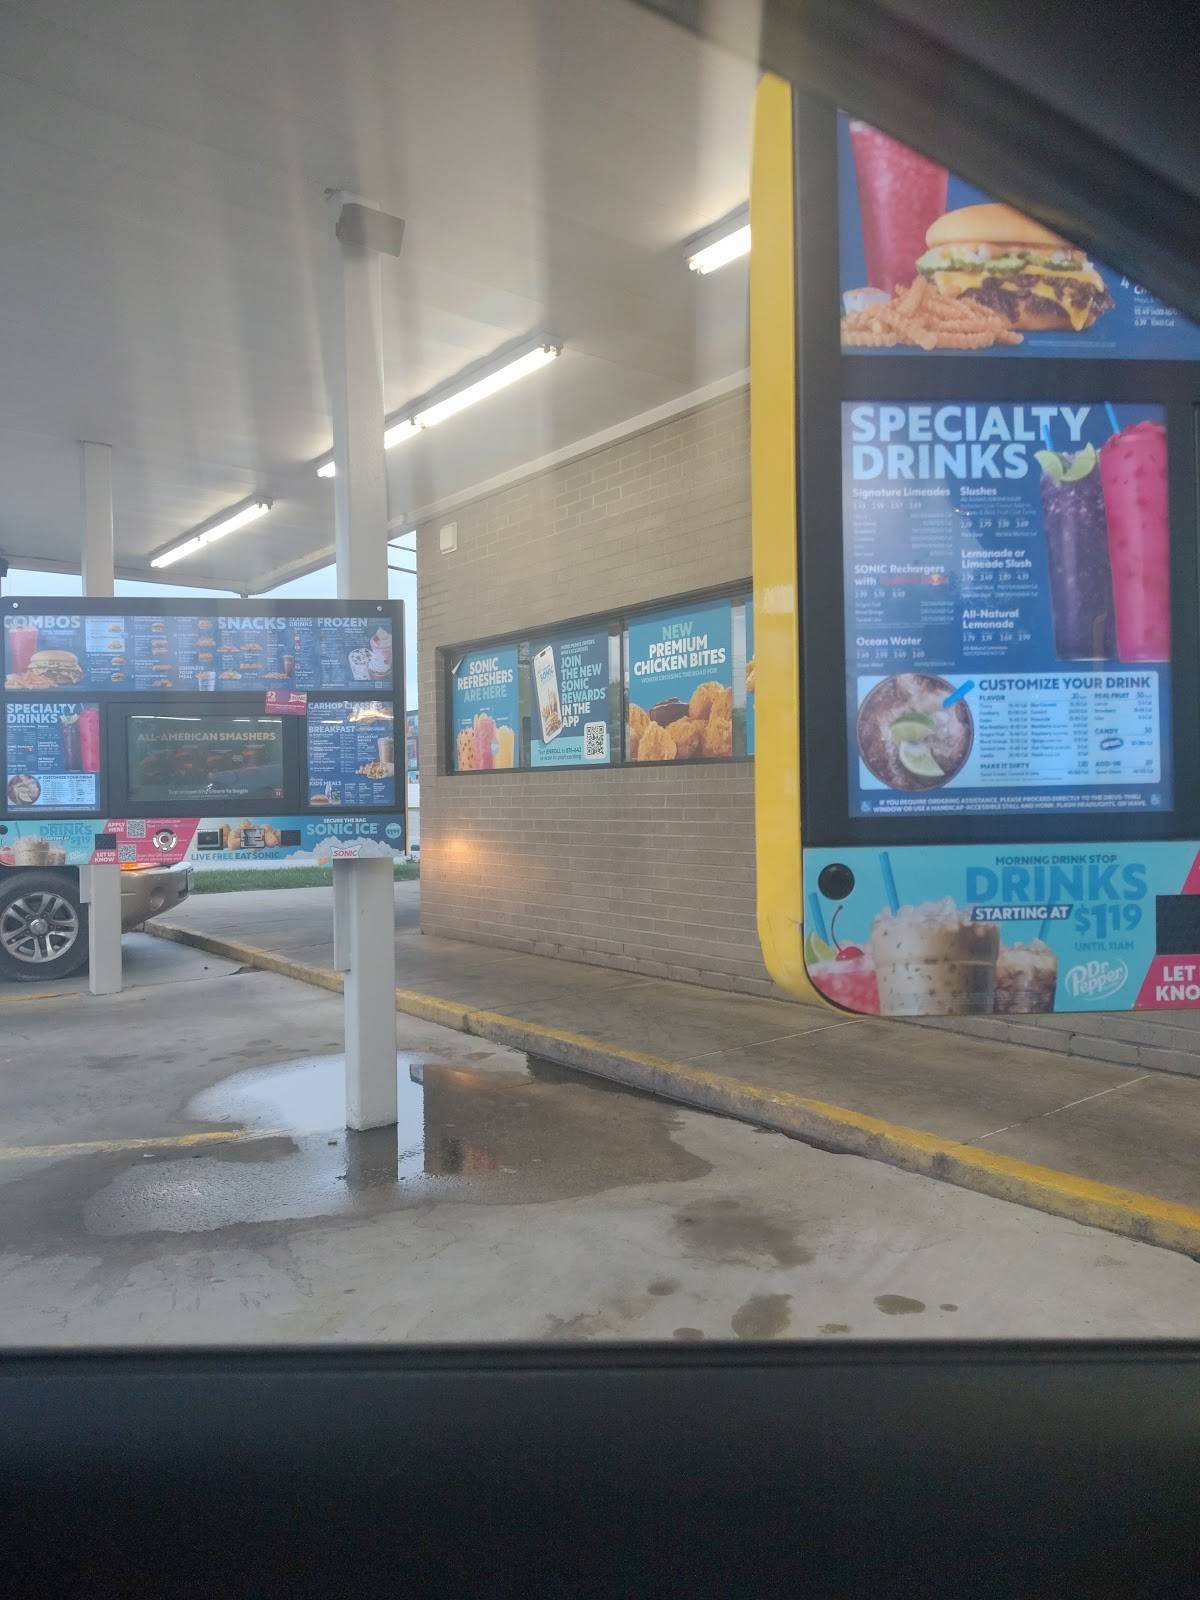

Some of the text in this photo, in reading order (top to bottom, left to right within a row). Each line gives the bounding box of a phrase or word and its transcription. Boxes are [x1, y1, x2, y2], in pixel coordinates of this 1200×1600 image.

[850, 406, 1092, 442] SPECIALTY
[852, 444, 1029, 480] DRINKS
[852, 487, 951, 500] Signature Limeades
[960, 487, 998, 496] Slushes
[961, 548, 1013, 558] Lemonade
[854, 564, 945, 576] SONIC Rechargers
[962, 559, 1032, 568] Limeade Slush
[856, 576, 877, 586] with
[962, 608, 1020, 618] All-Natural
[5, 616, 80, 628] COMBOS
[217, 617, 286, 630] SNACKS
[318, 618, 368, 627] FROZEN
[962, 620, 1015, 629] Lemonade
[662, 622, 694, 640] NEW
[649, 634, 708, 659] PREMIUM
[856, 636, 922, 646] Ocean Water
[469, 657, 499, 675] SONIC
[560, 654, 582, 669] JOIN
[634, 648, 726, 676] CHICKEN BITES
[561, 662, 602, 681] THE NEW
[458, 668, 514, 690] REFRESHERS
[561, 678, 589, 692] SONIC
[978, 677, 1151, 690] CUSTOMIZE YOUR DRINK
[464, 684, 507, 703] ARE HERE
[562, 688, 606, 704] REWARDS
[6, 704, 76, 714] SPECIALTY
[562, 702, 590, 715] IN THE
[8, 714, 58, 724] DRINKS
[562, 716, 580, 728] APP
[137, 732, 276, 742] ALL-AMERICAN SMASHERS
[40, 826, 92, 836] DRINKS
[307, 822, 378, 835] SONIC ICE
[213, 852, 234, 860] FREE
[995, 854, 1117, 866] MORNING DRINK STOP
[966, 863, 1148, 904] DRINKS
[975, 906, 1070, 920] STARTING AT
[1074, 942, 1106, 952] UNTIL
[1088, 960, 1110, 975] Dr
[1163, 966, 1196, 982] LET
[1072, 966, 1123, 997] Pepper
